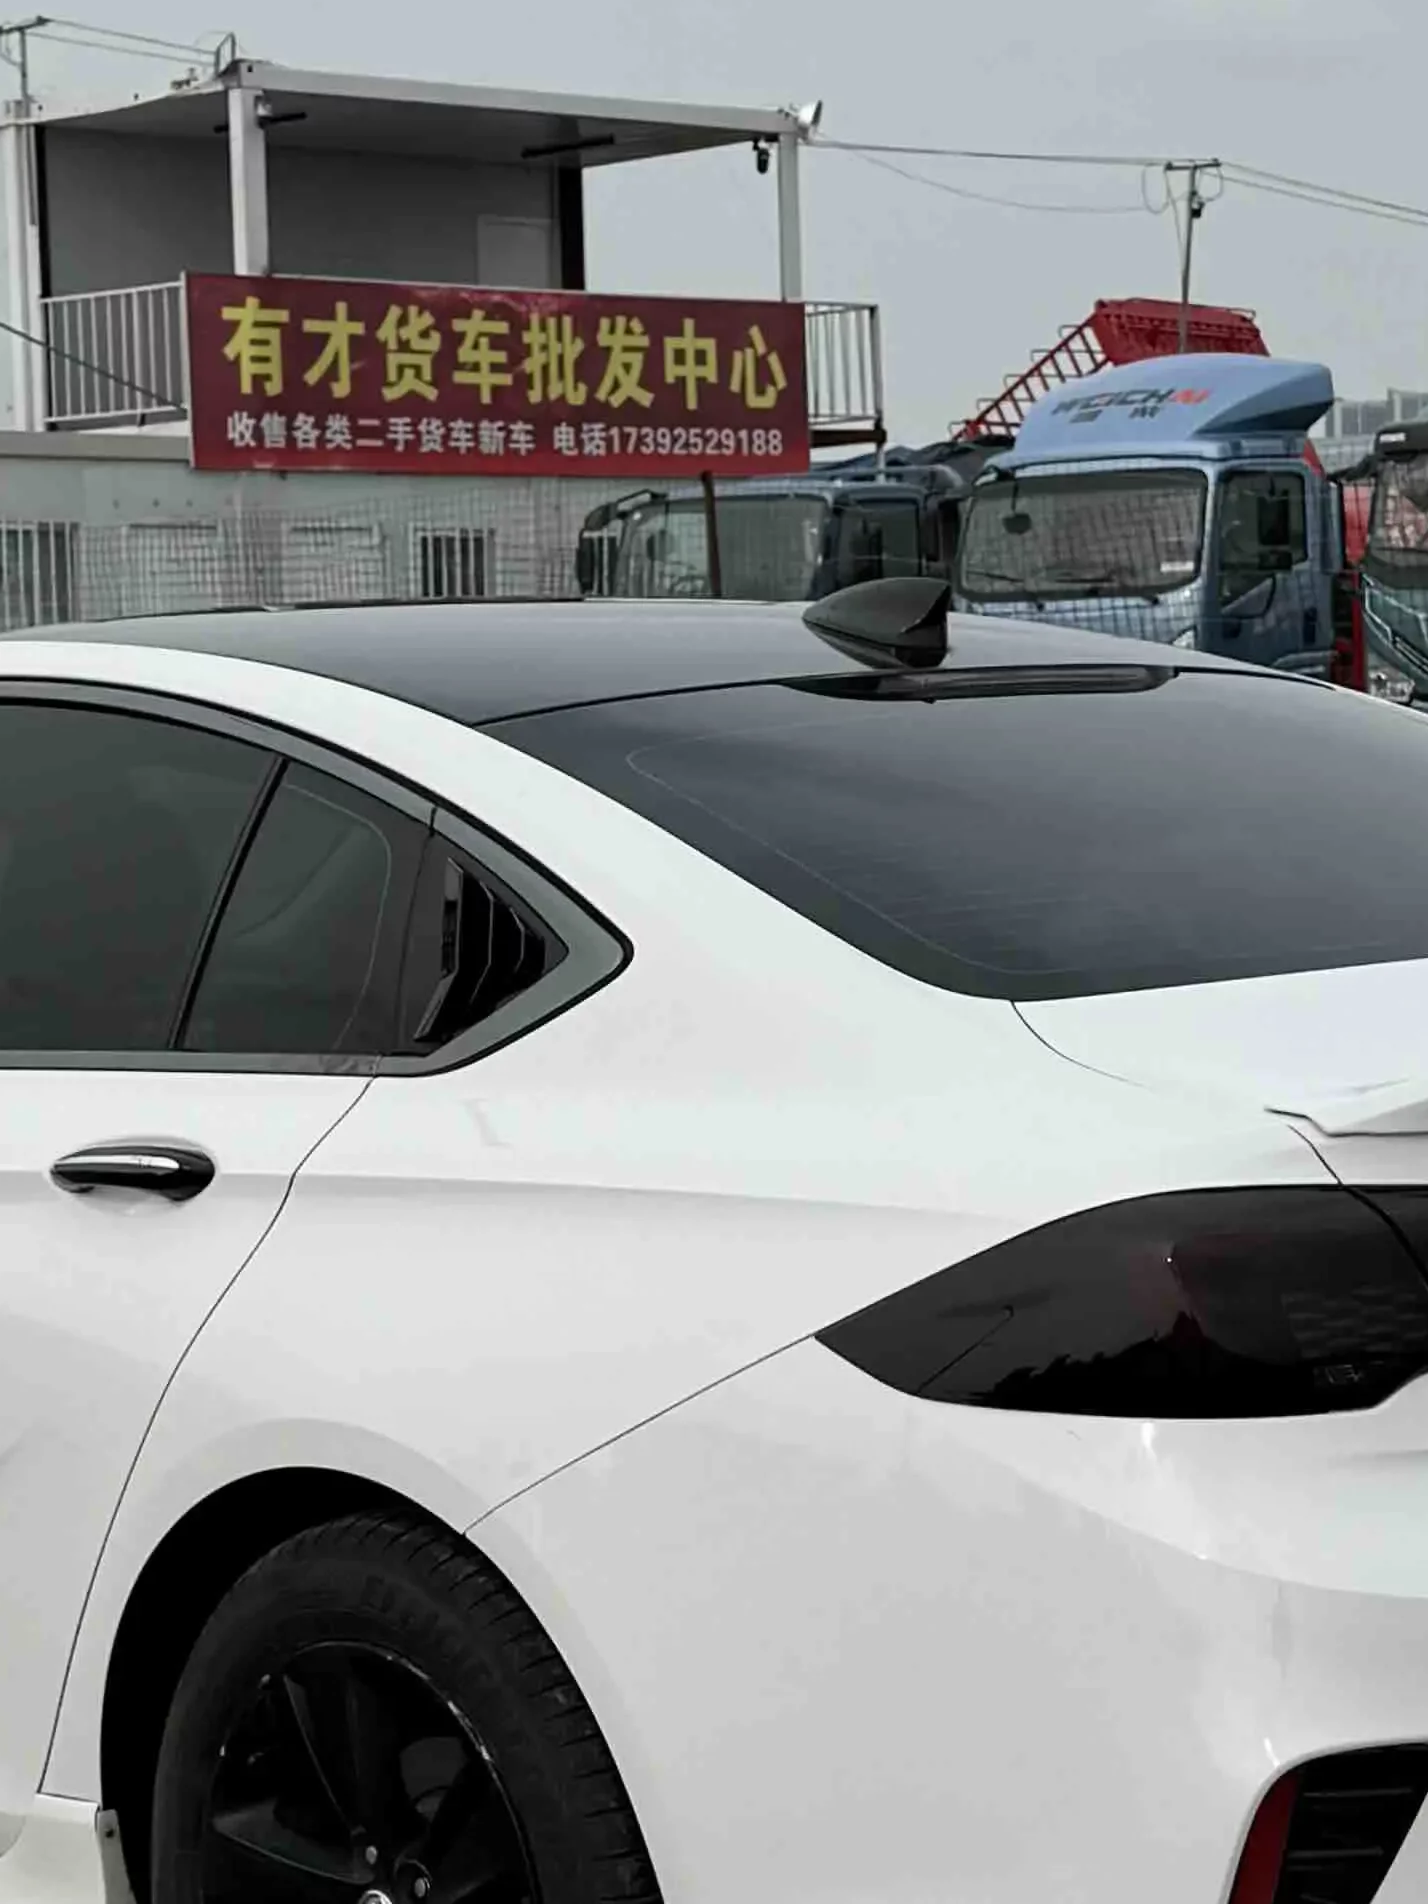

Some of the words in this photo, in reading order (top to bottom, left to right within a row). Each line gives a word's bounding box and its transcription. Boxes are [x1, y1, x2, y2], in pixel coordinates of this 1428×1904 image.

[221, 297, 788, 409] 有才货车批发中心
[227, 411, 536, 456] 收售各类二手货车新车
[553, 421, 784, 457] 电话17392529188
